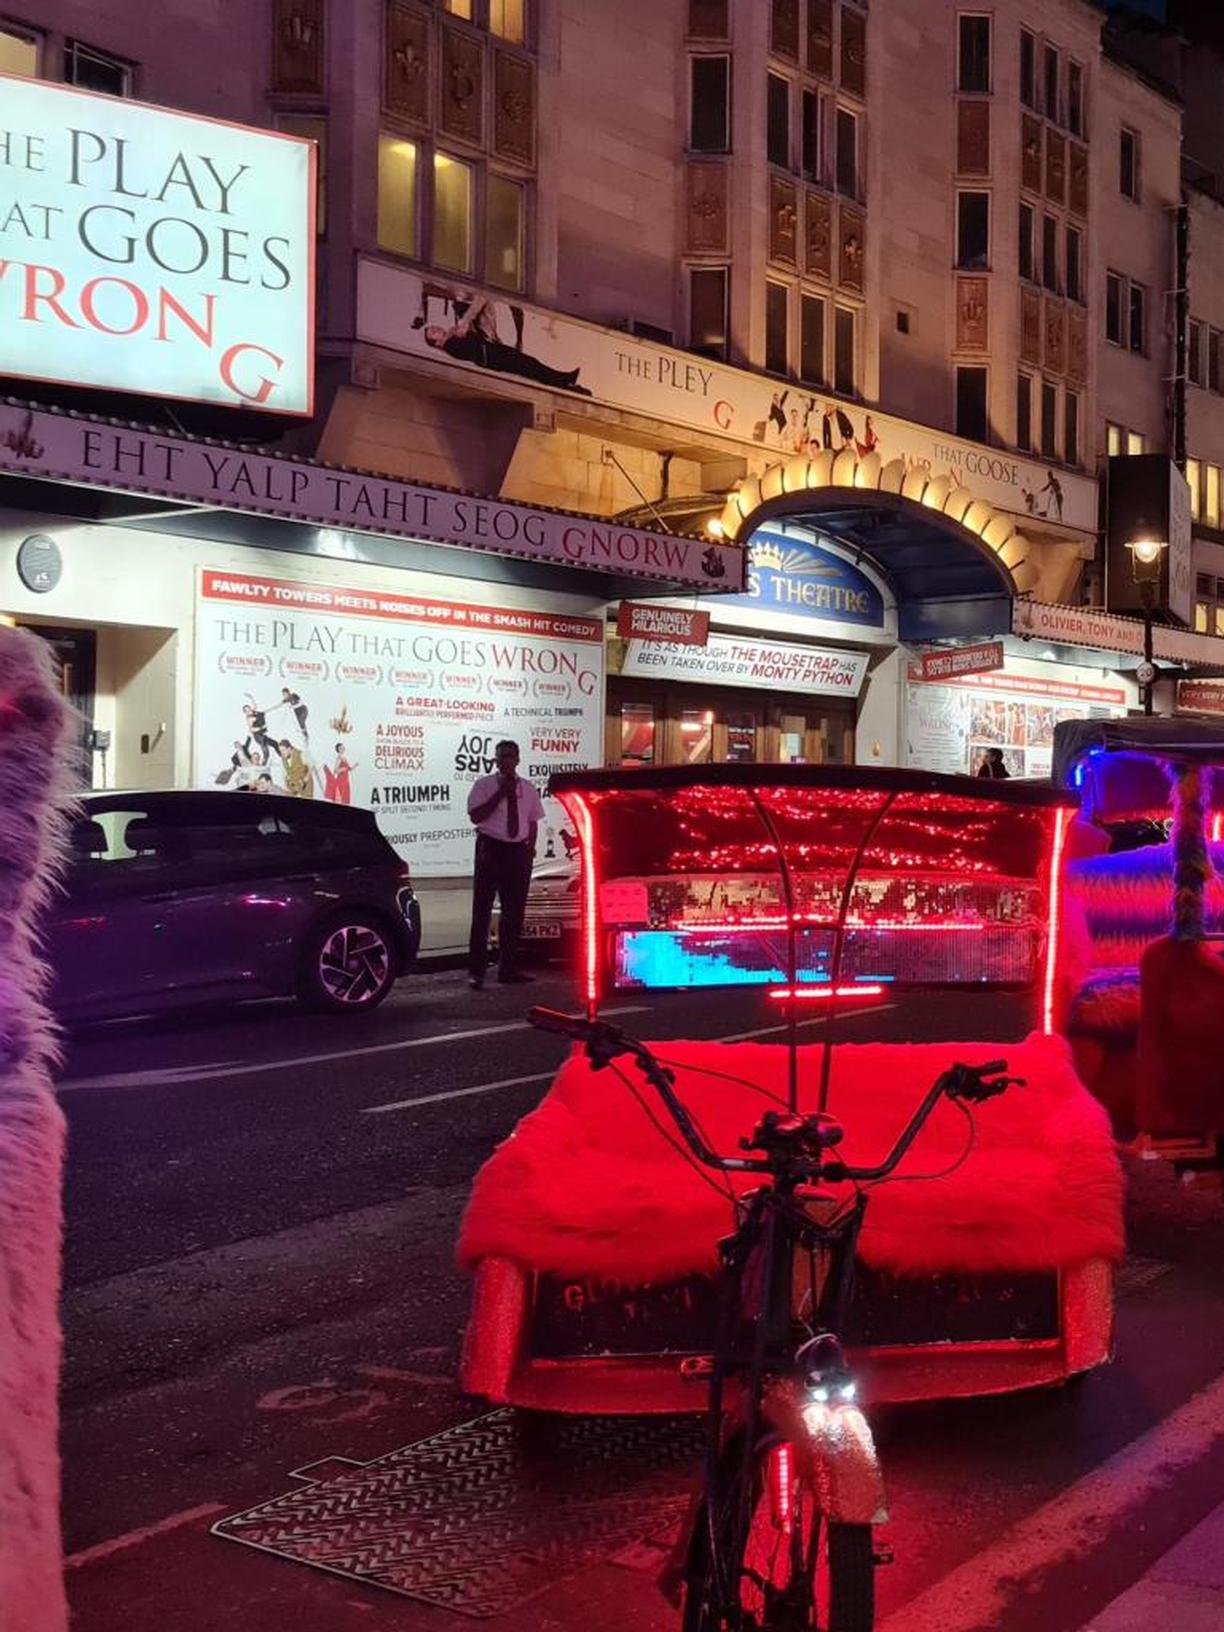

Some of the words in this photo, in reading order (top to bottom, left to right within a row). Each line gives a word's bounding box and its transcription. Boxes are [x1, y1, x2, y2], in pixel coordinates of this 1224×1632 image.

[66, 128, 251, 215] PLAY
[79, 205, 291, 291] GOES
[0, 259, 284, 404] RONG
[615, 351, 651, 379] THE
[659, 357, 712, 396] PLEY
[714, 400, 734, 429] G
[931, 443, 964, 466] THAT
[966, 452, 1018, 485] GOOSE
[82, 431, 184, 482] EHT
[203, 453, 309, 504] YALP
[326, 477, 437, 526] TAHT
[452, 501, 545, 546] SEOG
[562, 526, 689, 568] GNORW
[771, 576, 869, 614] THEATRE
[212, 580, 270, 597] FAWLTY
[273, 587, 332, 604] TOWERS
[334, 595, 379, 610] MEETS
[379, 600, 425, 615] NOISES
[427, 605, 451, 618] OFF
[453, 609, 466, 619] IN
[469, 611, 491, 624] THE
[494, 615, 531, 628] SMASH
[533, 619, 551, 631] HIT
[552, 622, 596, 636] COMEDY
[632, 608, 694, 625] GENUINELY
[631, 620, 691, 636] HILARIOUS
[1088, 621, 1114, 638] TONY
[215, 619, 266, 645] THE
[272, 620, 344, 653] PLAY
[347, 633, 405, 658] THAT
[412, 636, 486, 668] GOES
[491, 643, 597, 695] WRONG
[226, 656, 265, 667] WINNER
[730, 646, 758, 662] THE
[759, 650, 839, 670] MOUSETRAP
[840, 662, 857, 673] HAS
[286, 662, 322, 672] WINNER
[342, 665, 377, 676] WINNER
[638, 654, 668, 666] BEEN
[670, 656, 704, 670] TAKEN
[706, 660, 735, 672] OVER
[736, 663, 750, 674] BY
[751, 665, 800, 681] MONTY
[803, 670, 854, 686] PYTHON
[512, 708, 553, 717] TECHNICAL
[376, 724, 384, 737] A
[386, 724, 424, 738] JOYOUS
[529, 727, 553, 738] VERY
[555, 728, 582, 739] VERY
[376, 745, 424, 757] DELIRIOUS
[457, 735, 492, 755] JOY
[531, 739, 581, 753] FUNNY
[375, 757, 424, 771] CLIMAX
[455, 755, 496, 774] ARS
[371, 788, 380, 804] A
[384, 784, 450, 803] TRIUMPH
[421, 829, 477, 842] PREPOSTER
